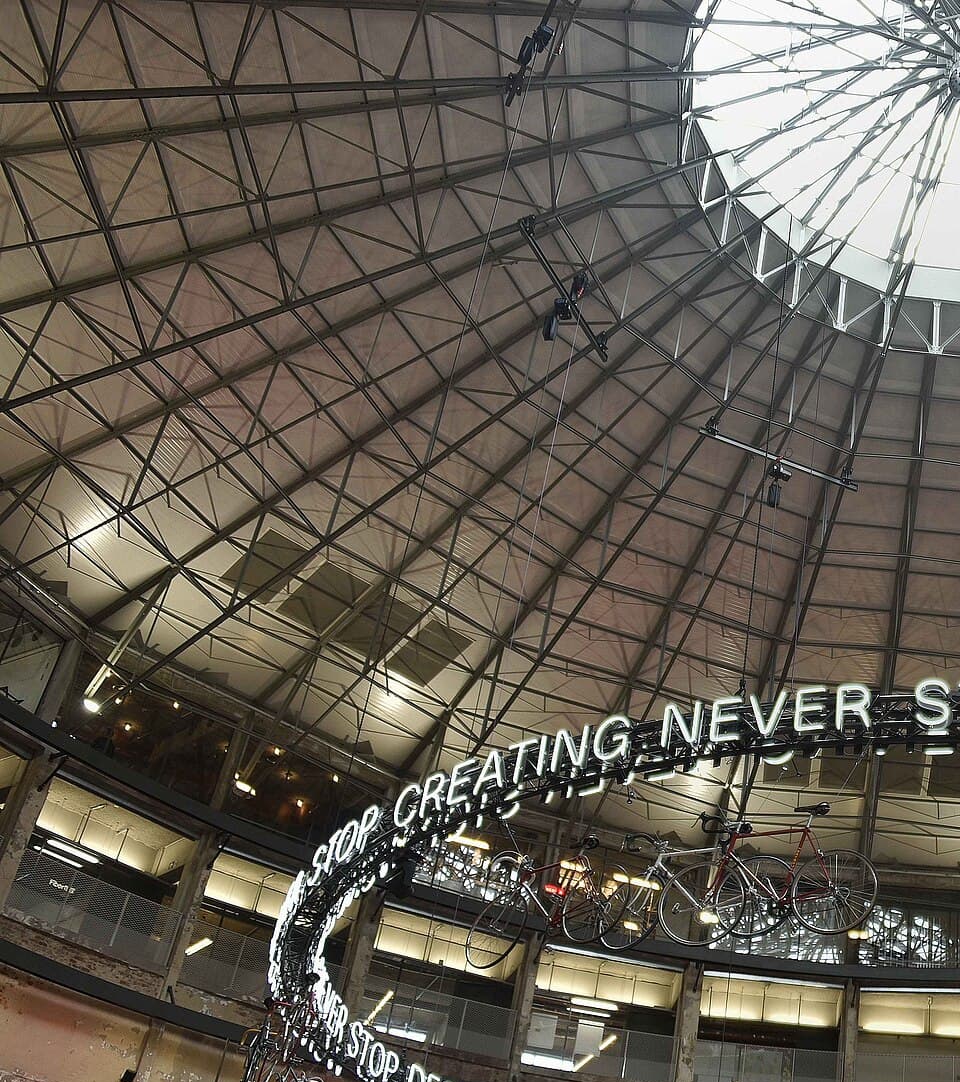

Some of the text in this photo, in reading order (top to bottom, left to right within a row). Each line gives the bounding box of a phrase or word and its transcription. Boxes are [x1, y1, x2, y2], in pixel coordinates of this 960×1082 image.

[308, 805, 379, 886] STOP
[393, 714, 632, 827] CREATING
[660, 683, 871, 748] NEVER
[349, 1021, 399, 1080] STOP
